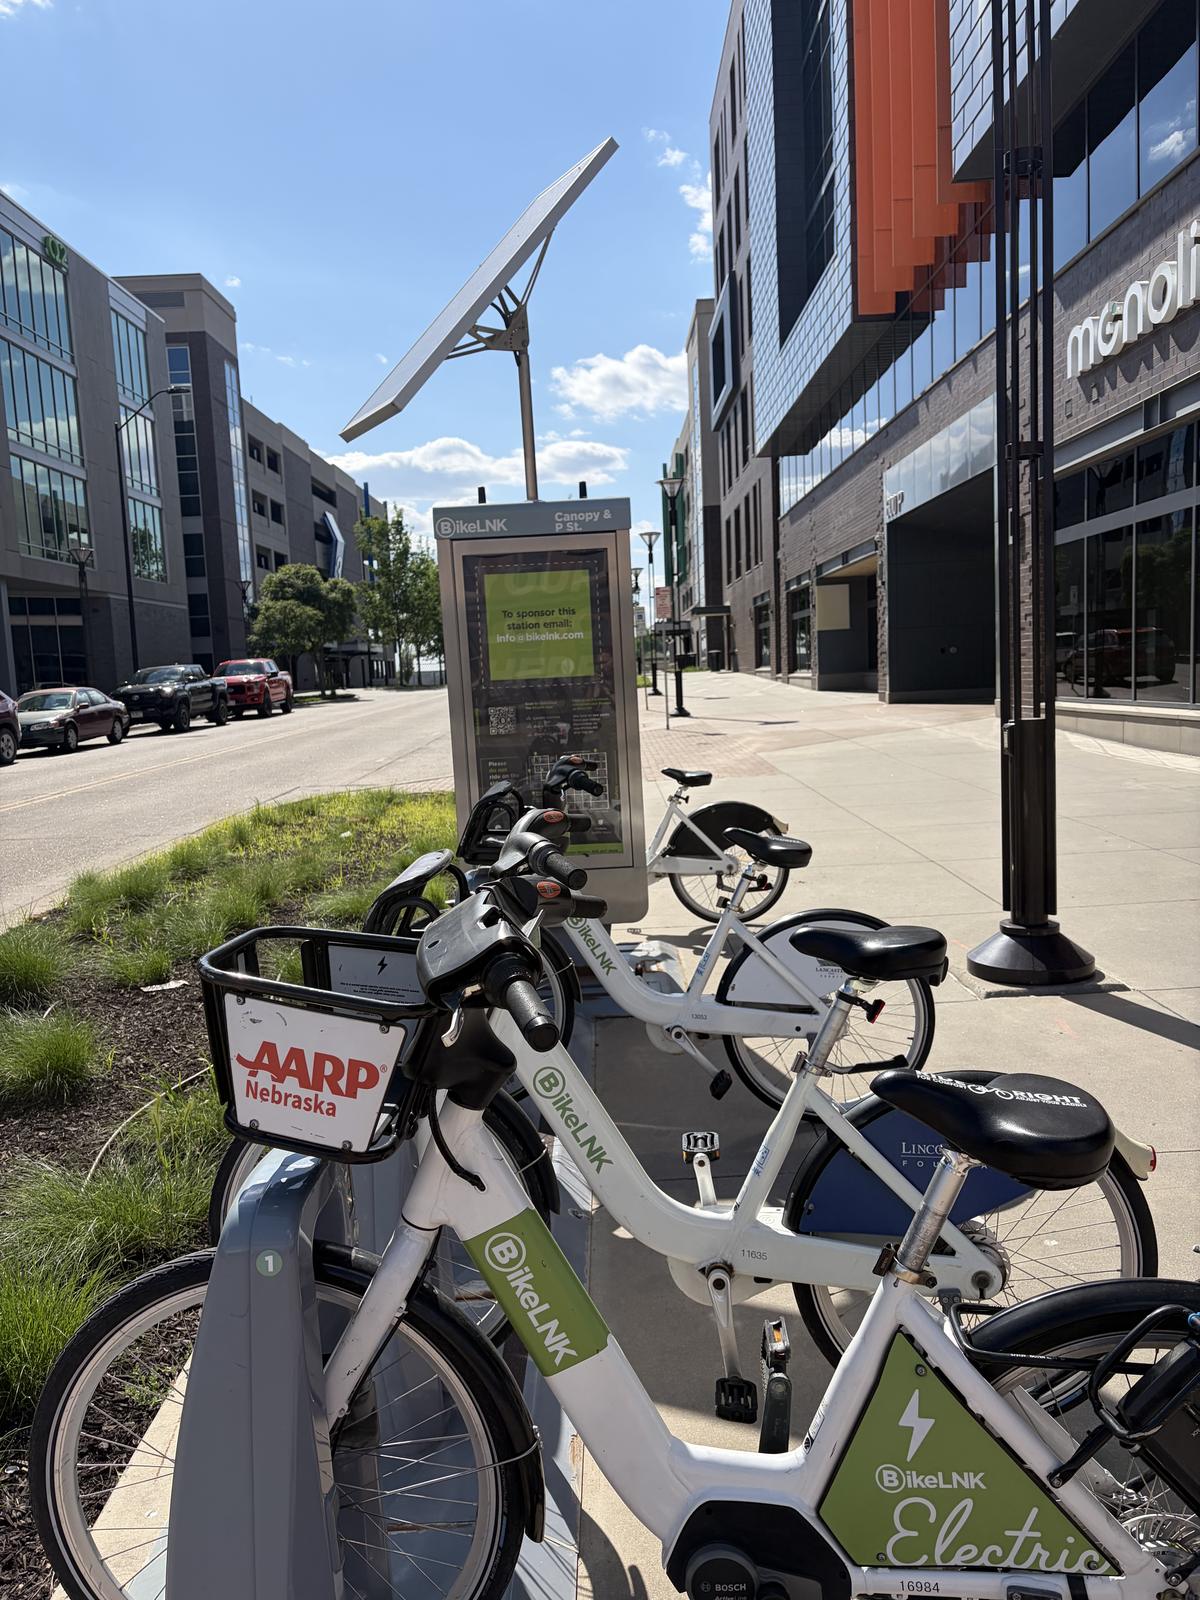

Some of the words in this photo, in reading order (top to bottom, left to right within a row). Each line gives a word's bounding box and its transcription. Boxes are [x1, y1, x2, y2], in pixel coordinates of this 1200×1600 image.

[555, 510, 600, 522] Canopy
[603, 509, 612, 519] &
[436, 517, 508, 538] BikeLNK
[555, 523, 563, 533] P
[566, 521, 583, 532] St.
[502, 609, 514, 619] To
[516, 607, 556, 620] sponsor
[558, 607, 576, 616] this
[507, 619, 540, 630] station
[543, 619, 572, 628] email:
[245, 1079, 337, 1117] Nebraska
[1014, 1090, 1082, 1104] RIGHT
[533, 1066, 614, 1175] BikeLNK
[741, 1249, 768, 1261] 11635
[263, 1255, 275, 1273] 1
[484, 1231, 580, 1366] BikeLNK
[875, 1463, 988, 1494] BikeLNK
[886, 1496, 1111, 1574] Electric
[714, 1583, 747, 1592] BOSCH
[899, 1579, 941, 1593] 16984
